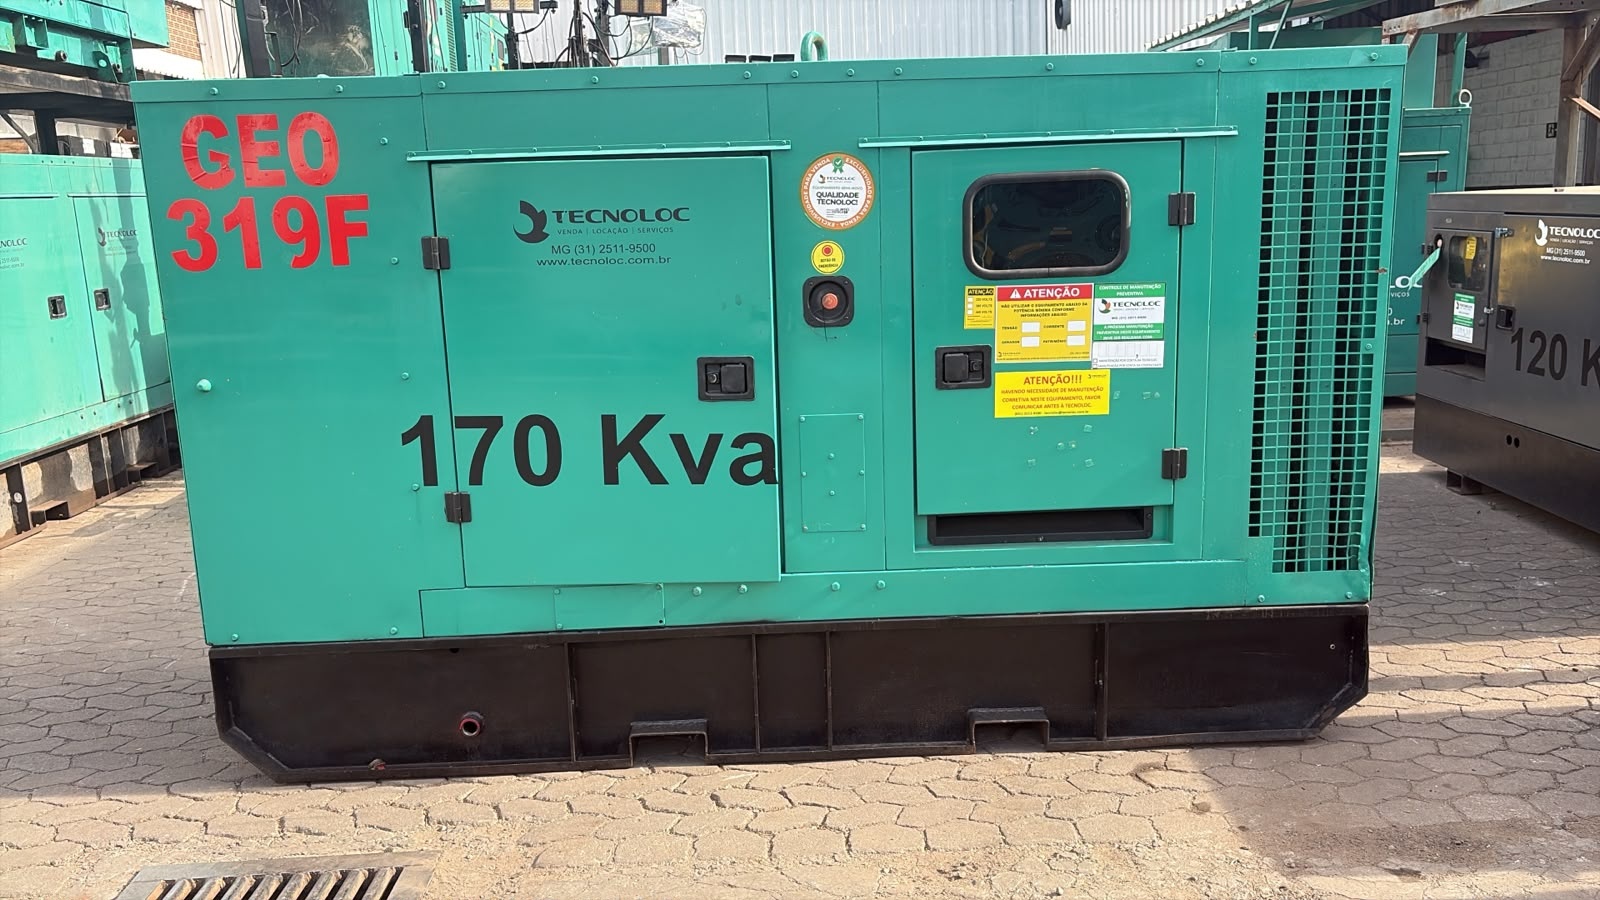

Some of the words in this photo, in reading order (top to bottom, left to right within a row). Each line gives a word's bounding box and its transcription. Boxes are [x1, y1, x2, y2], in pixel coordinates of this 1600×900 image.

[180, 111, 340, 190] GEO
[816, 191, 860, 199] QUALIDADE
[552, 207, 690, 224] TECNOLOC
[166, 194, 370, 272] 319F
[592, 226, 629, 236] LOCAÇÃO
[637, 226, 674, 234] SERVIÇOS
[551, 245, 571, 255] MG
[574, 244, 596, 256] (31)
[599, 243, 656, 254] 2511-9500
[536, 256, 672, 266] www.tecnoloc.com.br
[1023, 286, 1080, 300] ATENÇÃO
[1511, 328, 1568, 381] 120
[1023, 374, 1082, 386] ATENÇÃO!!!
[401, 414, 562, 487] 170
[601, 414, 779, 487] Kva
